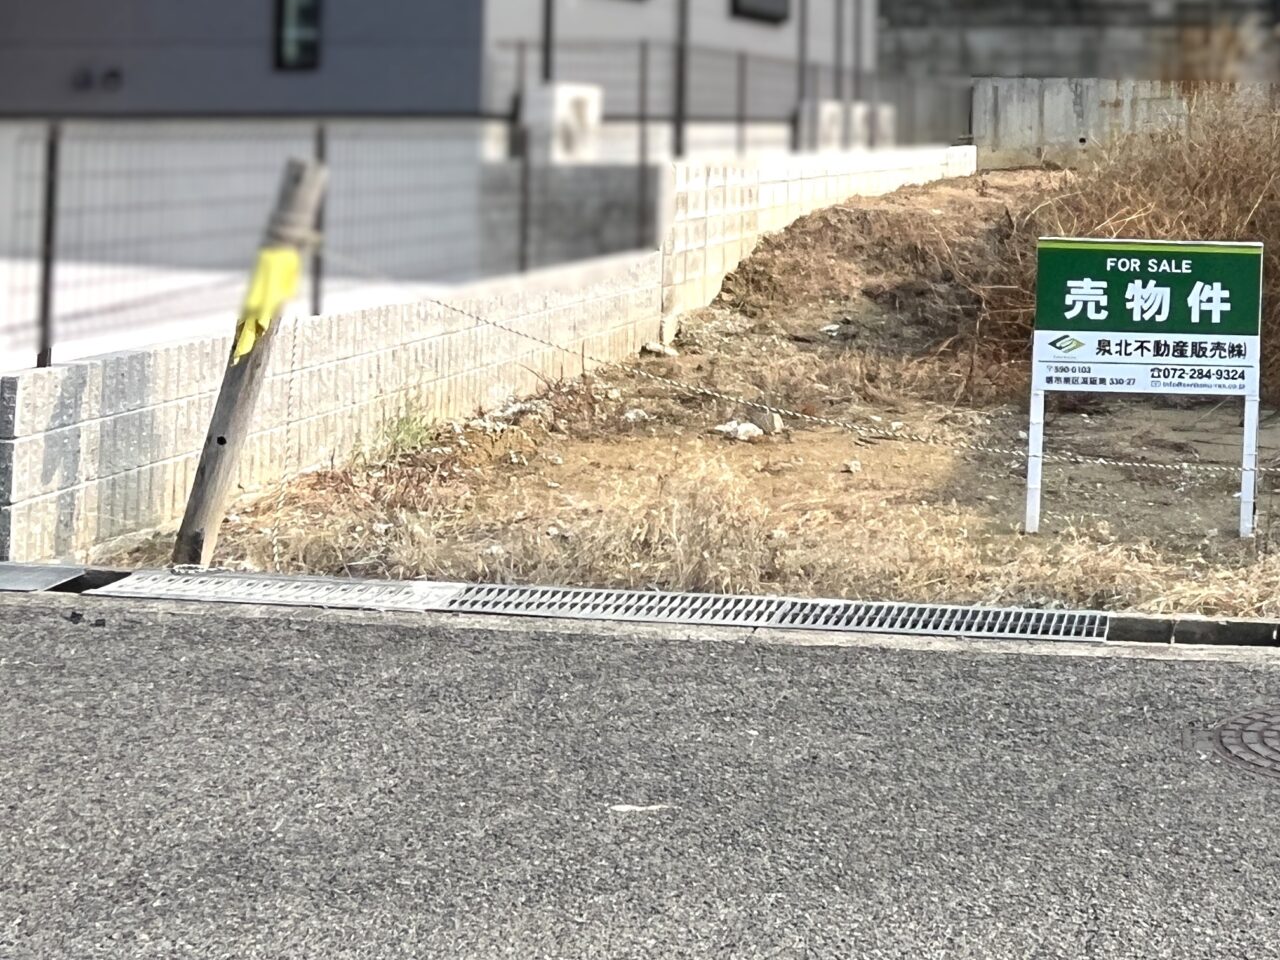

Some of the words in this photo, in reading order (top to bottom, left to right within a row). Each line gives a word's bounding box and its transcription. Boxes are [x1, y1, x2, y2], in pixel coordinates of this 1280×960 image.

[1106, 258, 1140, 272] FOR
[1147, 259, 1192, 273] SALE
[1064, 278, 1231, 323] 売物件
[1162, 367, 1245, 380] 072-284-9324
